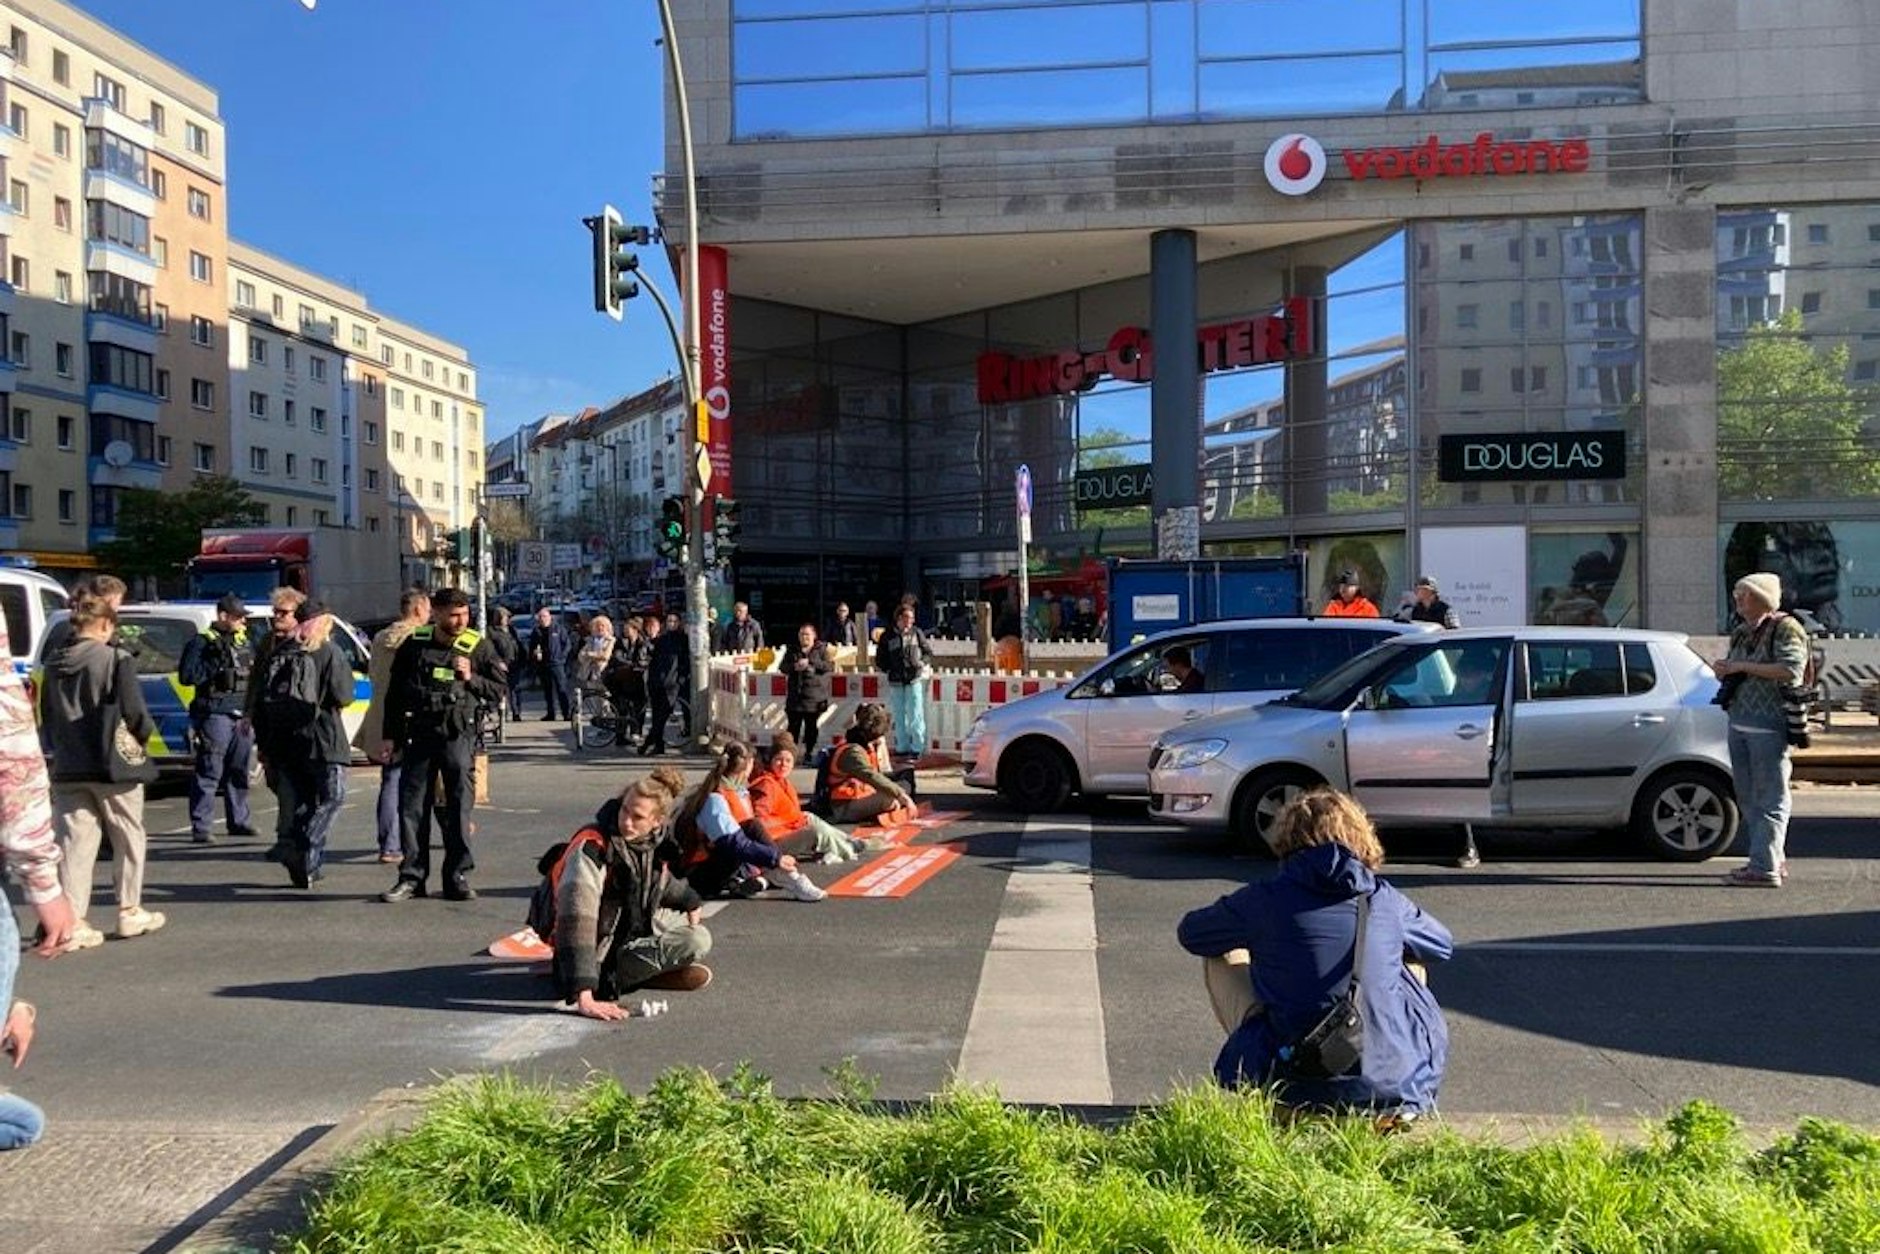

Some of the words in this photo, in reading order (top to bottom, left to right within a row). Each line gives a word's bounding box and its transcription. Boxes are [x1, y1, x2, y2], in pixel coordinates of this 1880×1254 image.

[1344, 132, 1590, 181] vodafone
[709, 288, 726, 381] vodafone
[977, 316, 1287, 406] RING-CTER
[1463, 441, 1603, 470] DOUGLAS
[1077, 472, 1154, 501] DOUGLA
[528, 550, 543, 564] 30
